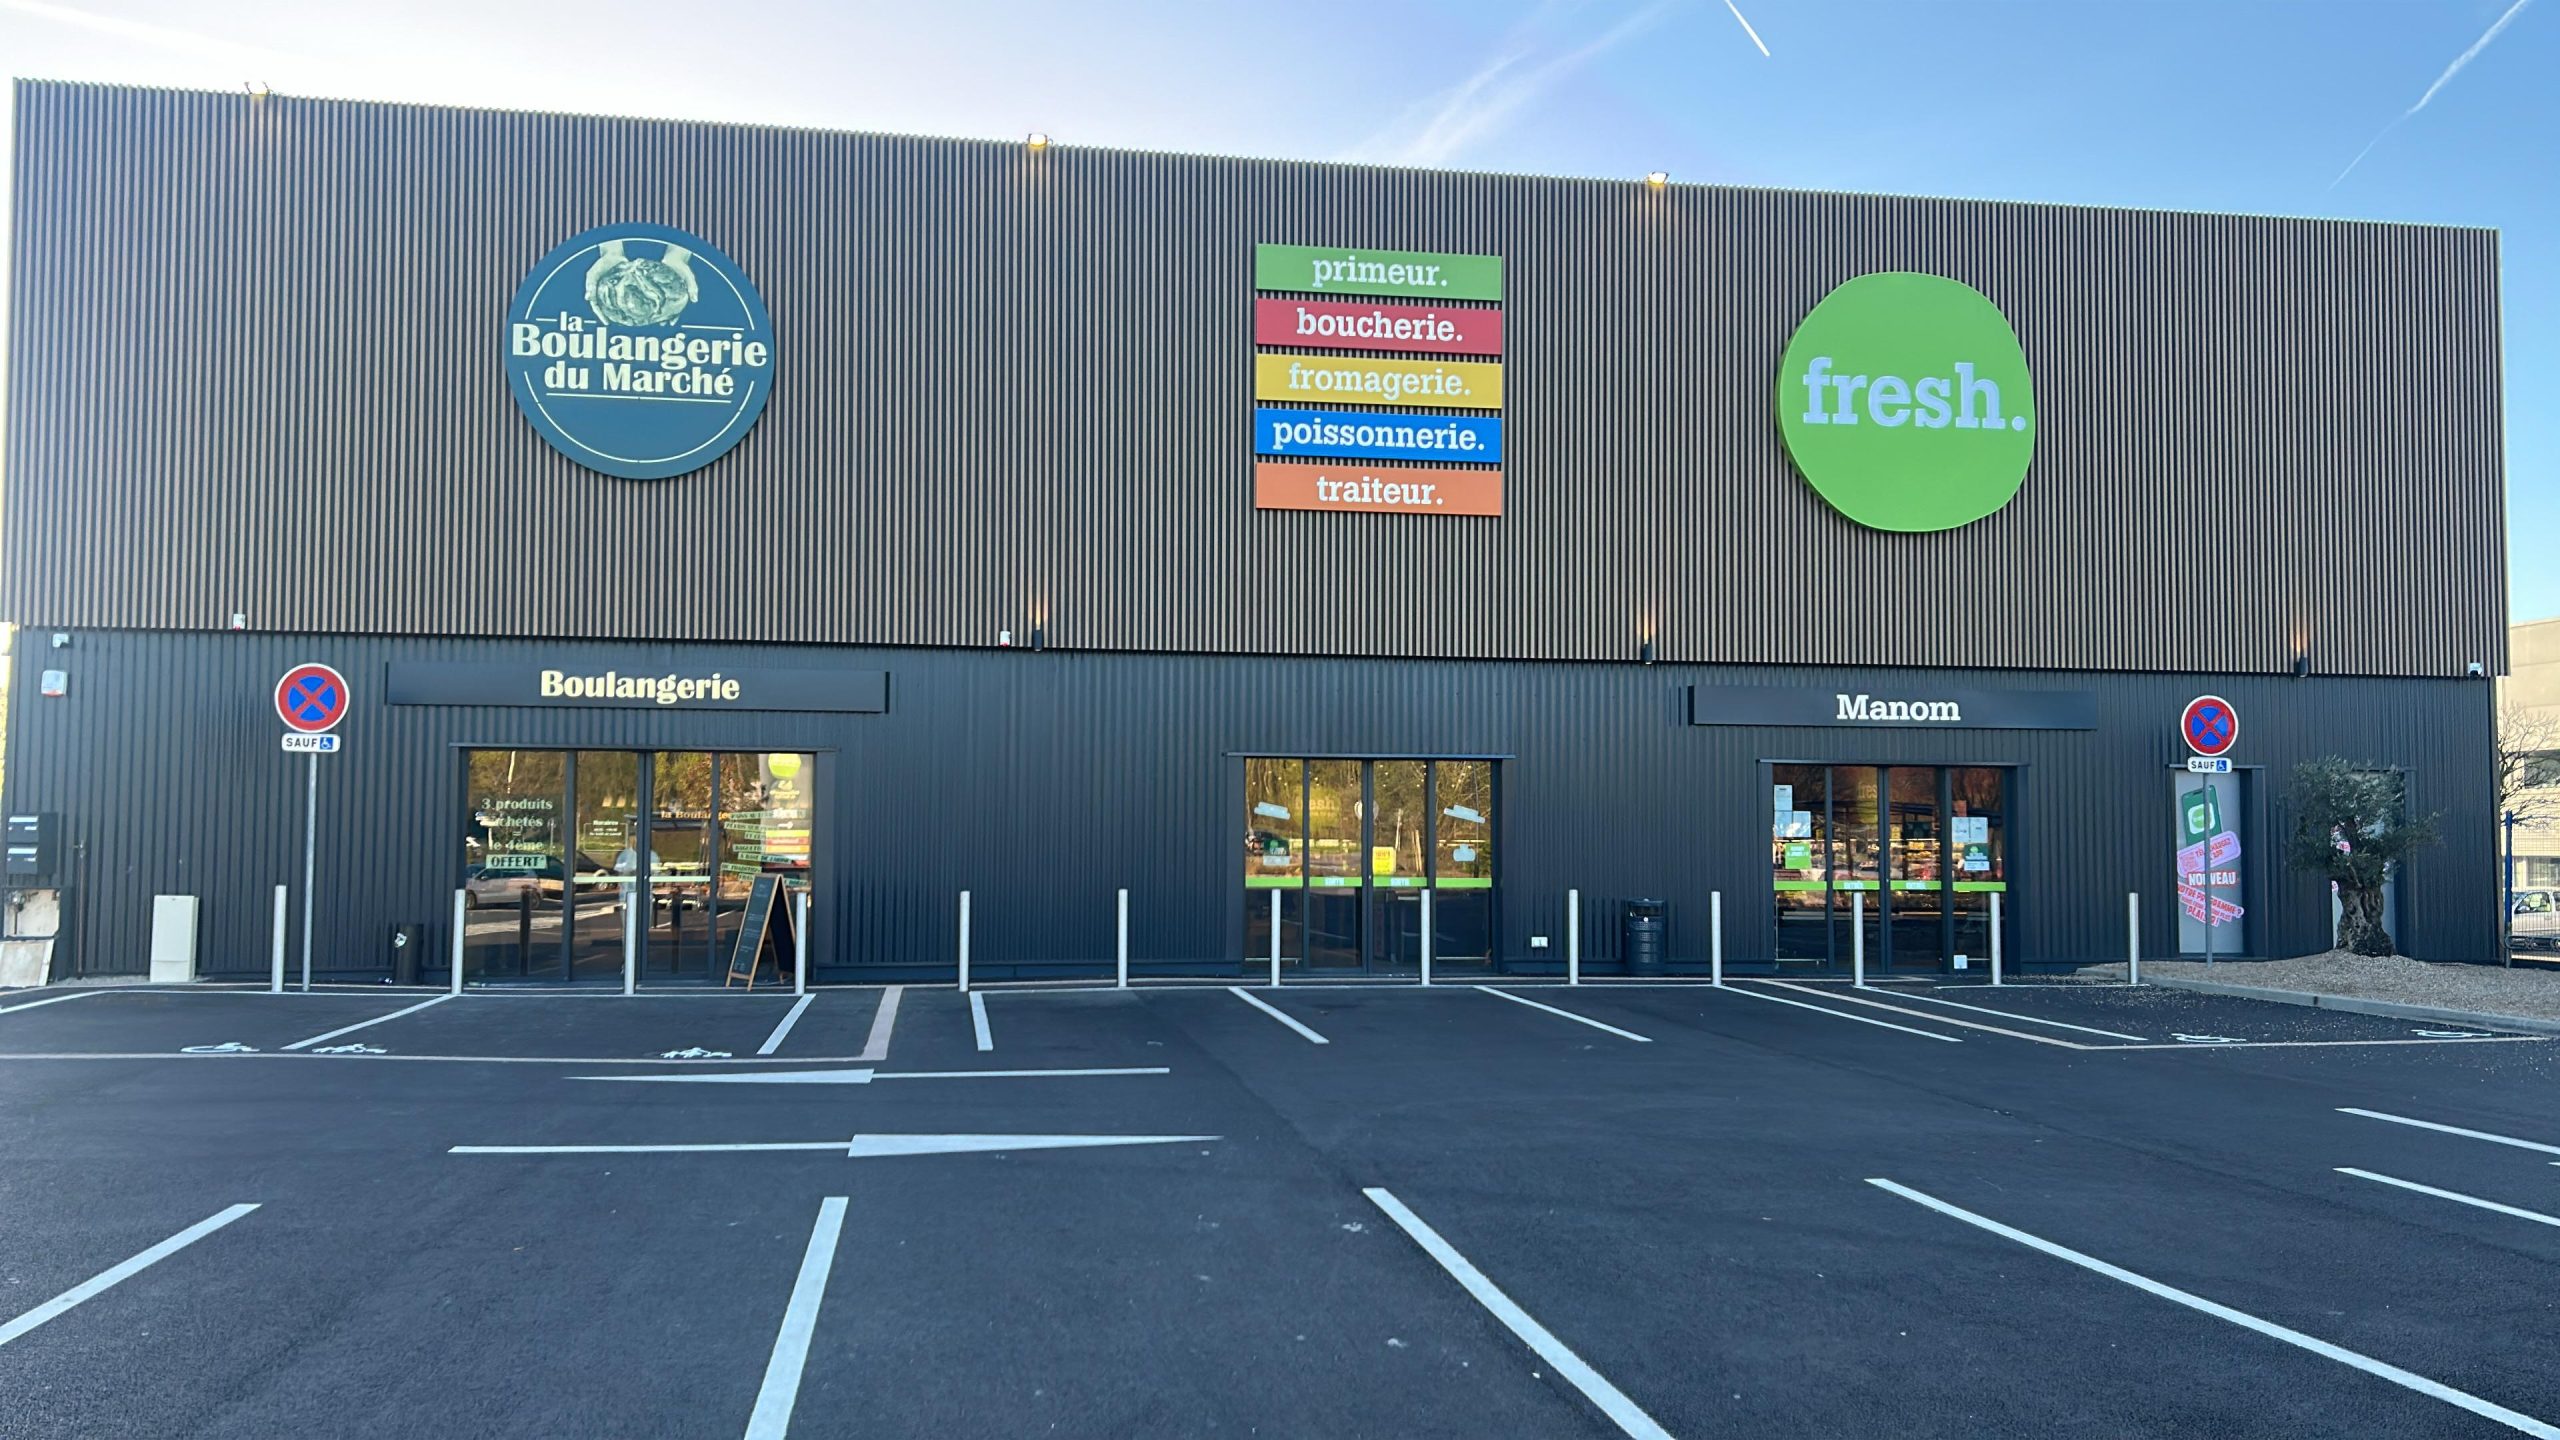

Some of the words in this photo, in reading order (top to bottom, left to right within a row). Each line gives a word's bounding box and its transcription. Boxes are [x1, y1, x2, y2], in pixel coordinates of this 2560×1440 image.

[1312, 255, 1448, 288] primeur.
[560, 311, 584, 332] la
[1296, 307, 1463, 342] boucherie.
[511, 322, 767, 370] Boulangerie
[544, 361, 588, 390] du
[602, 363, 734, 396] Marché
[1288, 362, 1472, 401] fromagerie.
[1802, 356, 2027, 431] fresh.
[1272, 417, 1485, 451] poissonnerie.
[1316, 475, 1443, 505] traiteur.
[541, 669, 741, 705] Boulangerie
[1836, 694, 1961, 721] Manom
[286, 737, 318, 748] SAUF
[2191, 760, 2215, 770] SAUF
[481, 798, 491, 810] 3
[495, 798, 554, 811] produits
[492, 815, 544, 827] chetés
